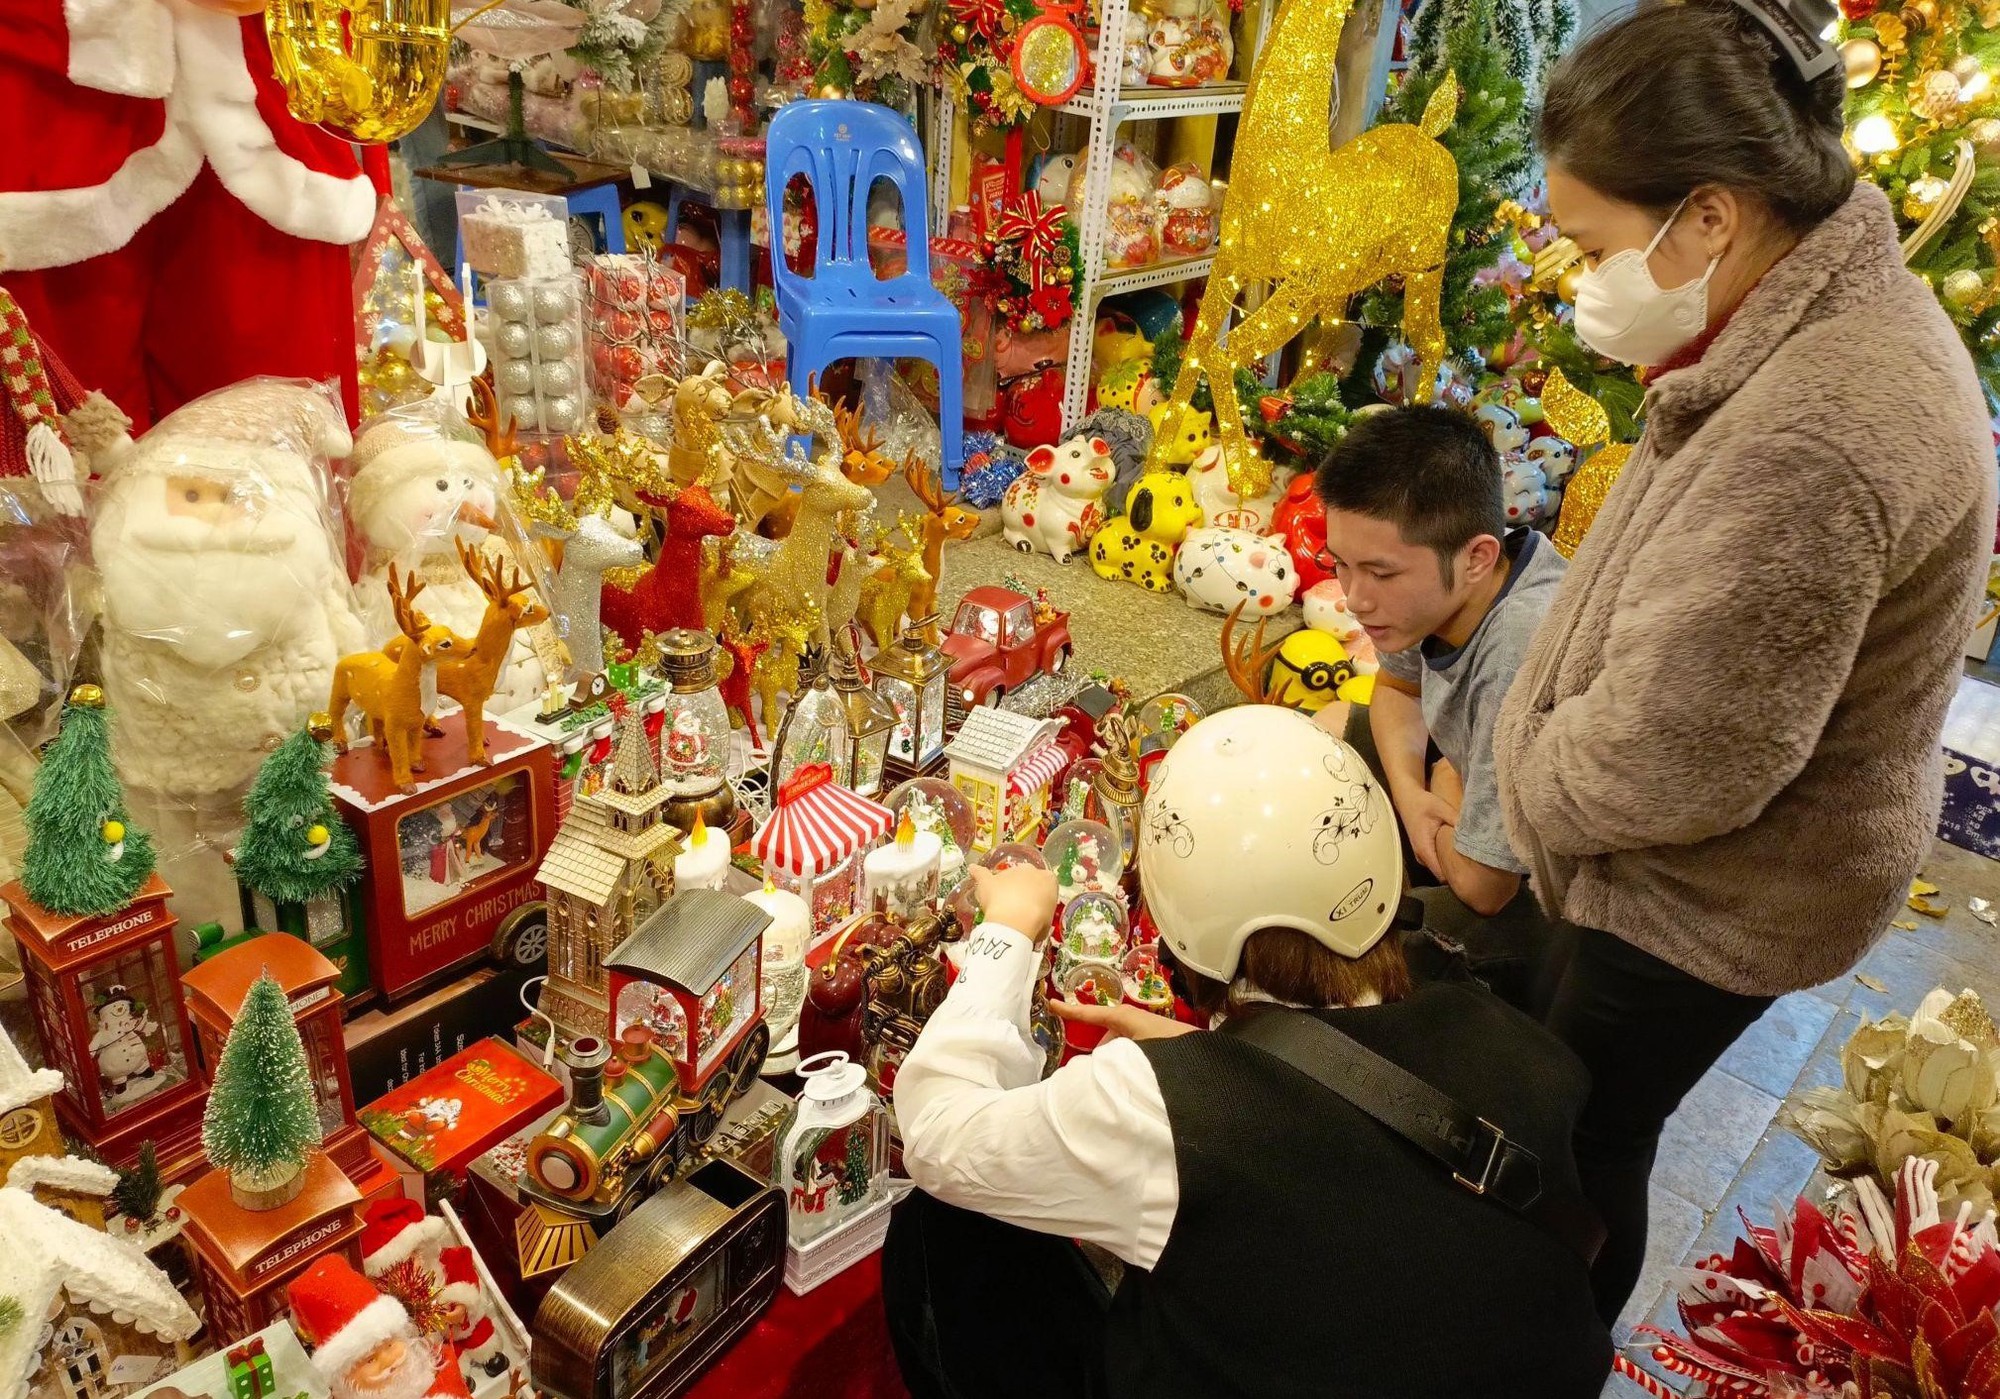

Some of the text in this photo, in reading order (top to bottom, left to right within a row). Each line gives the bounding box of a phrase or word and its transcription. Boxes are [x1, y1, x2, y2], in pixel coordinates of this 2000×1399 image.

[67, 910, 154, 952] TELEPHONE
[409, 882, 541, 956] MERRY CHRISTMAS
[454, 1069, 516, 1106] Christmas!
[477, 1065, 513, 1093] Merry
[255, 1219, 342, 1274] TELEPHONE
